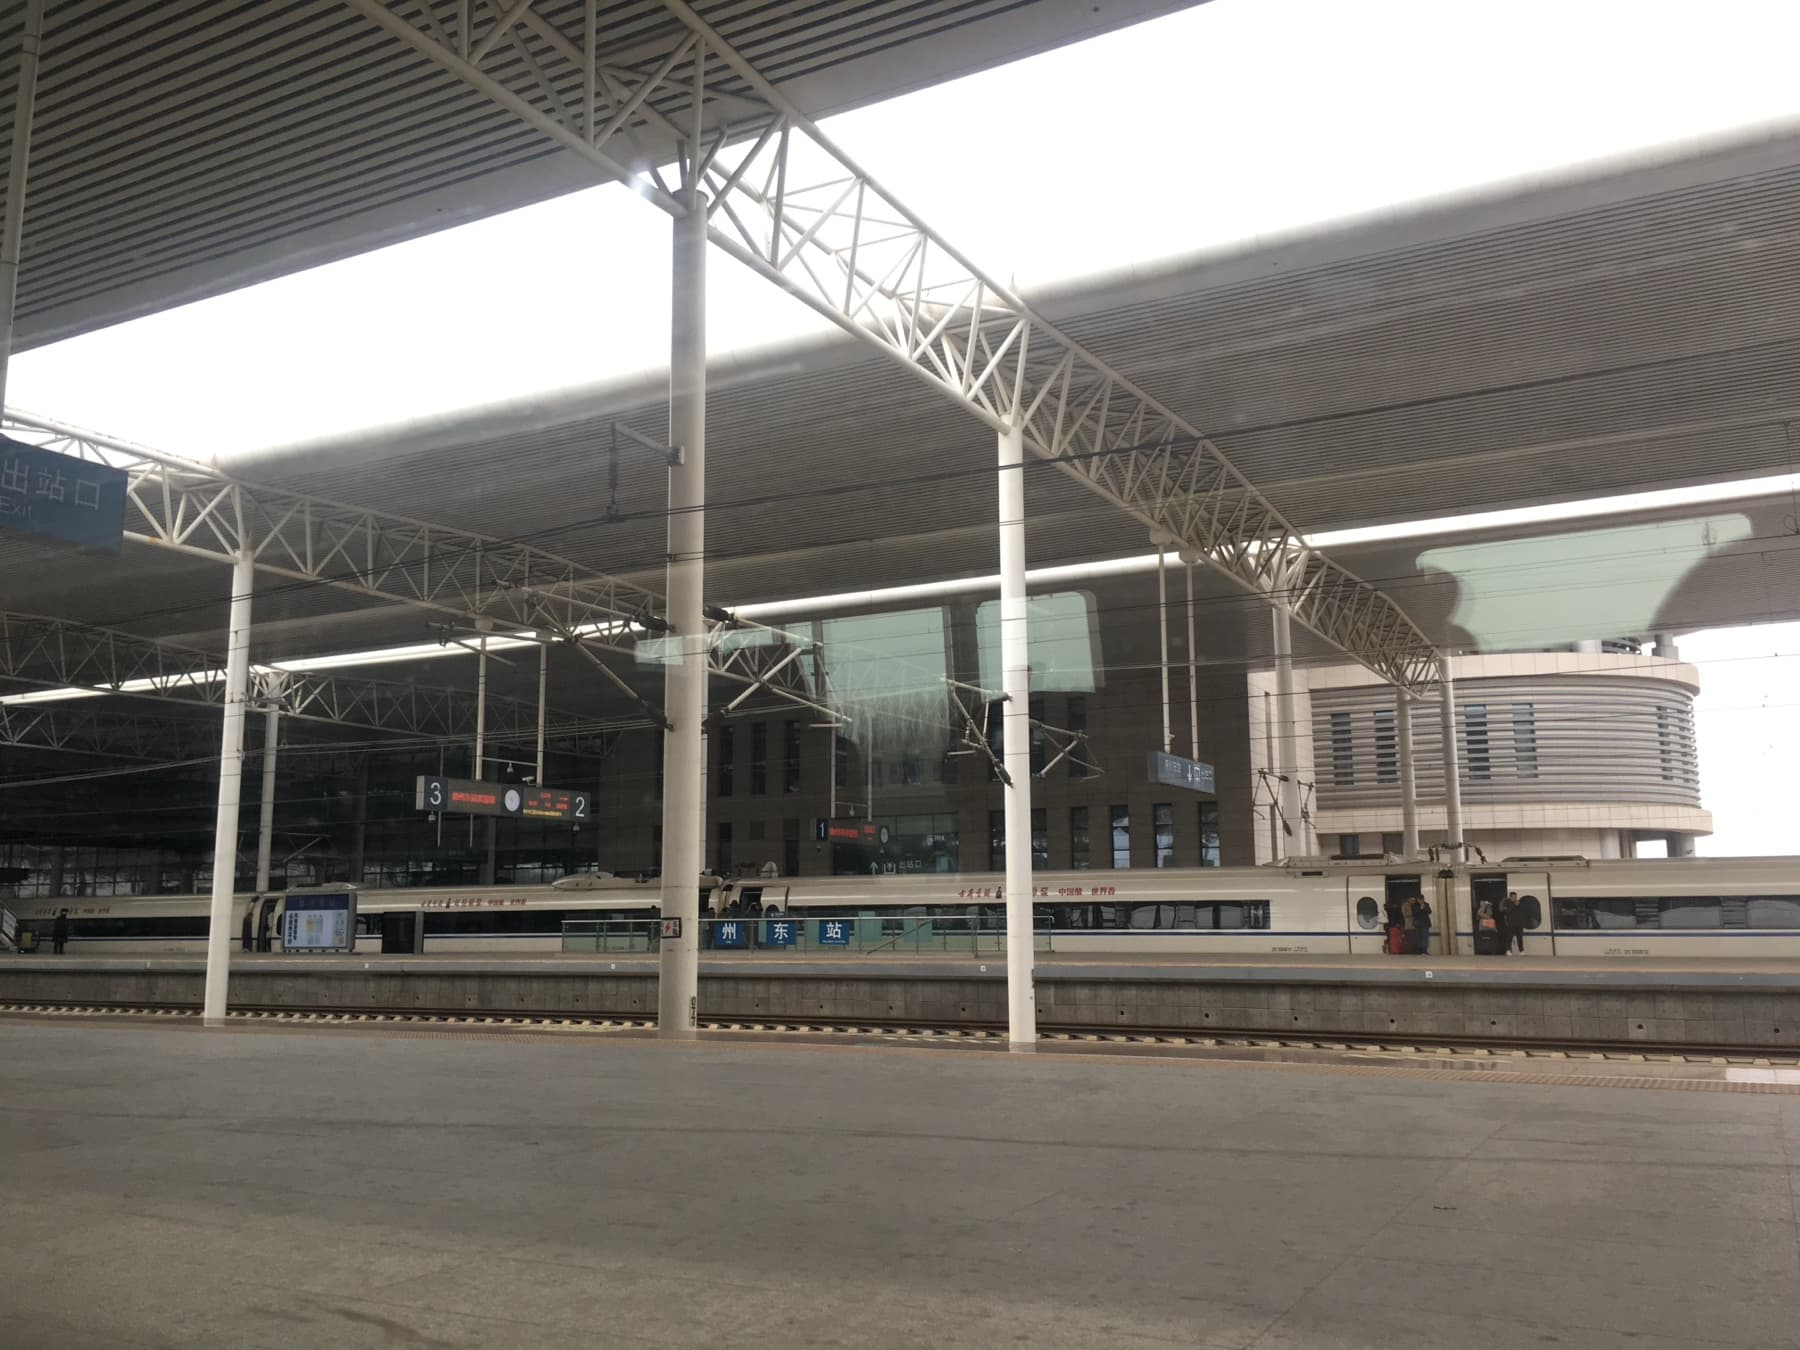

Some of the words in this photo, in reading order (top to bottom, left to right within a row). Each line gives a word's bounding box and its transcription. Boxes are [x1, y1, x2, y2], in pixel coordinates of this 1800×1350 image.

[1, 458, 100, 511] 出站口
[429, 782, 442, 805] 3
[575, 796, 585, 817] 2
[820, 822, 825, 838] 1
[722, 922, 737, 940] 州
[773, 922, 789, 940] 东
[826, 921, 842, 939] 站
